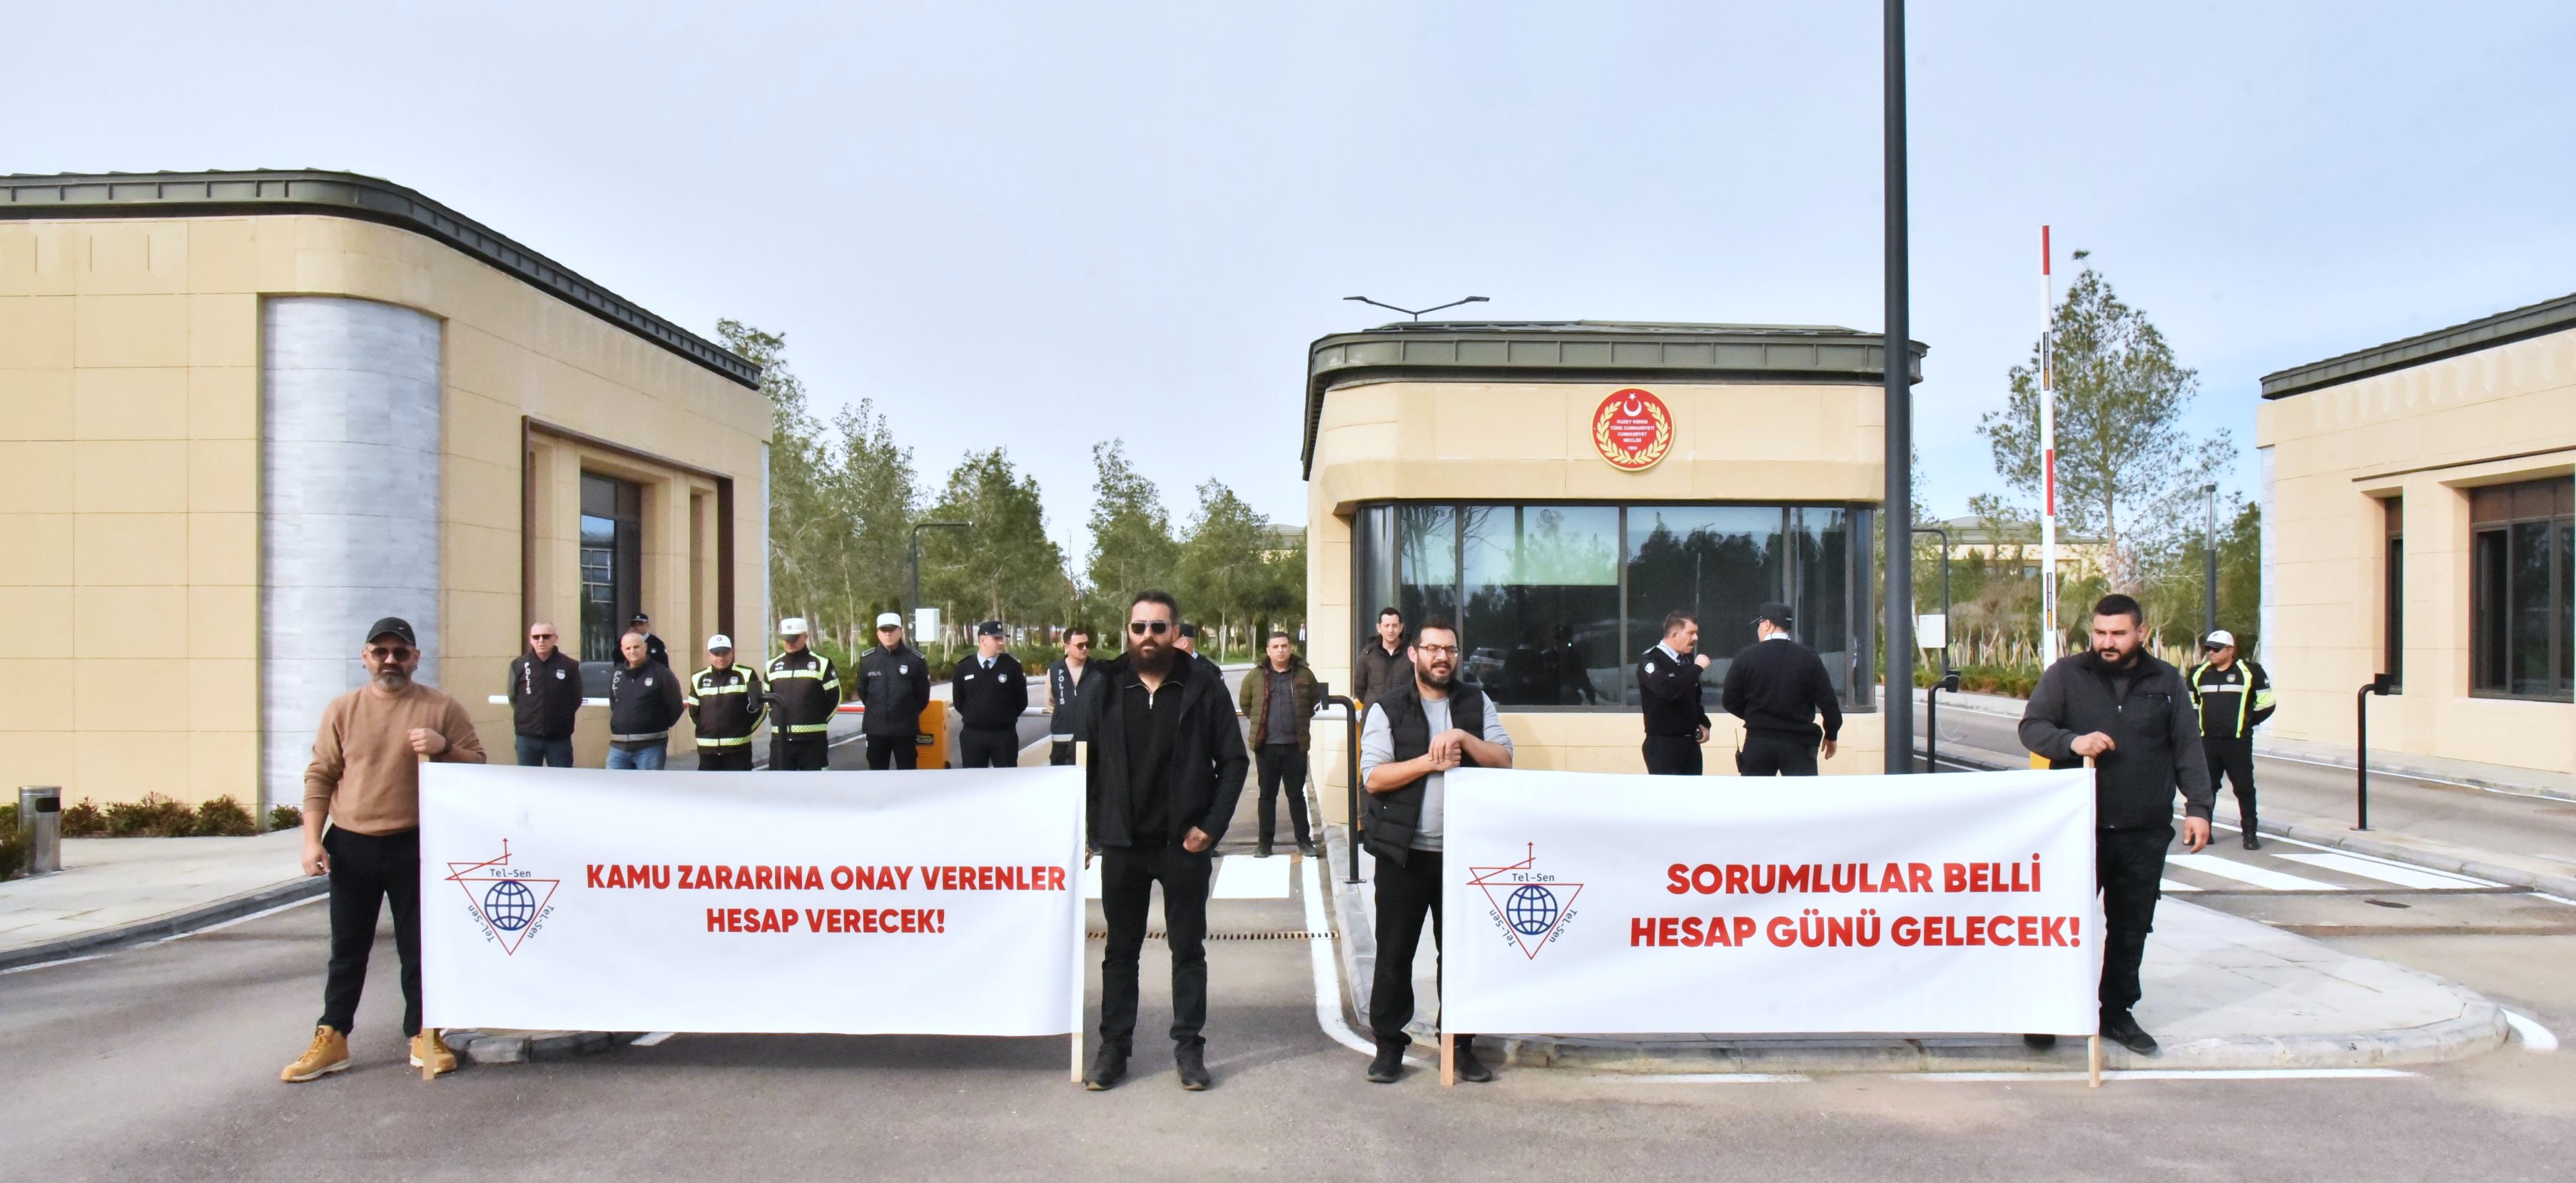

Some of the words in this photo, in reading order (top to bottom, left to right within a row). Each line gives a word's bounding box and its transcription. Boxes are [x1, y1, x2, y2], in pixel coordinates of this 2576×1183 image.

[490, 868, 532, 878] Tel-Sen
[587, 864, 671, 889] KAMU
[678, 865, 824, 890] ZARARINA
[831, 865, 913, 890] ONAY
[921, 865, 1065, 890] VERENLER
[1512, 873, 1555, 882] Tel-Sen
[1666, 862, 1933, 895] SORUMLULAR
[1944, 853, 2041, 893] BELLİ
[468, 905, 495, 943] Tel-Sen
[527, 905, 555, 939] Tel-Sen
[707, 908, 799, 933] HESAP
[806, 908, 945, 933] VERECEK!
[1489, 908, 1516, 948] Tel-Sen
[1548, 908, 1578, 943] Tel-Sen
[1631, 916, 1756, 948] HESAP
[1767, 908, 1881, 948] GÜNÜ
[1891, 915, 2081, 948] GELECEK!
